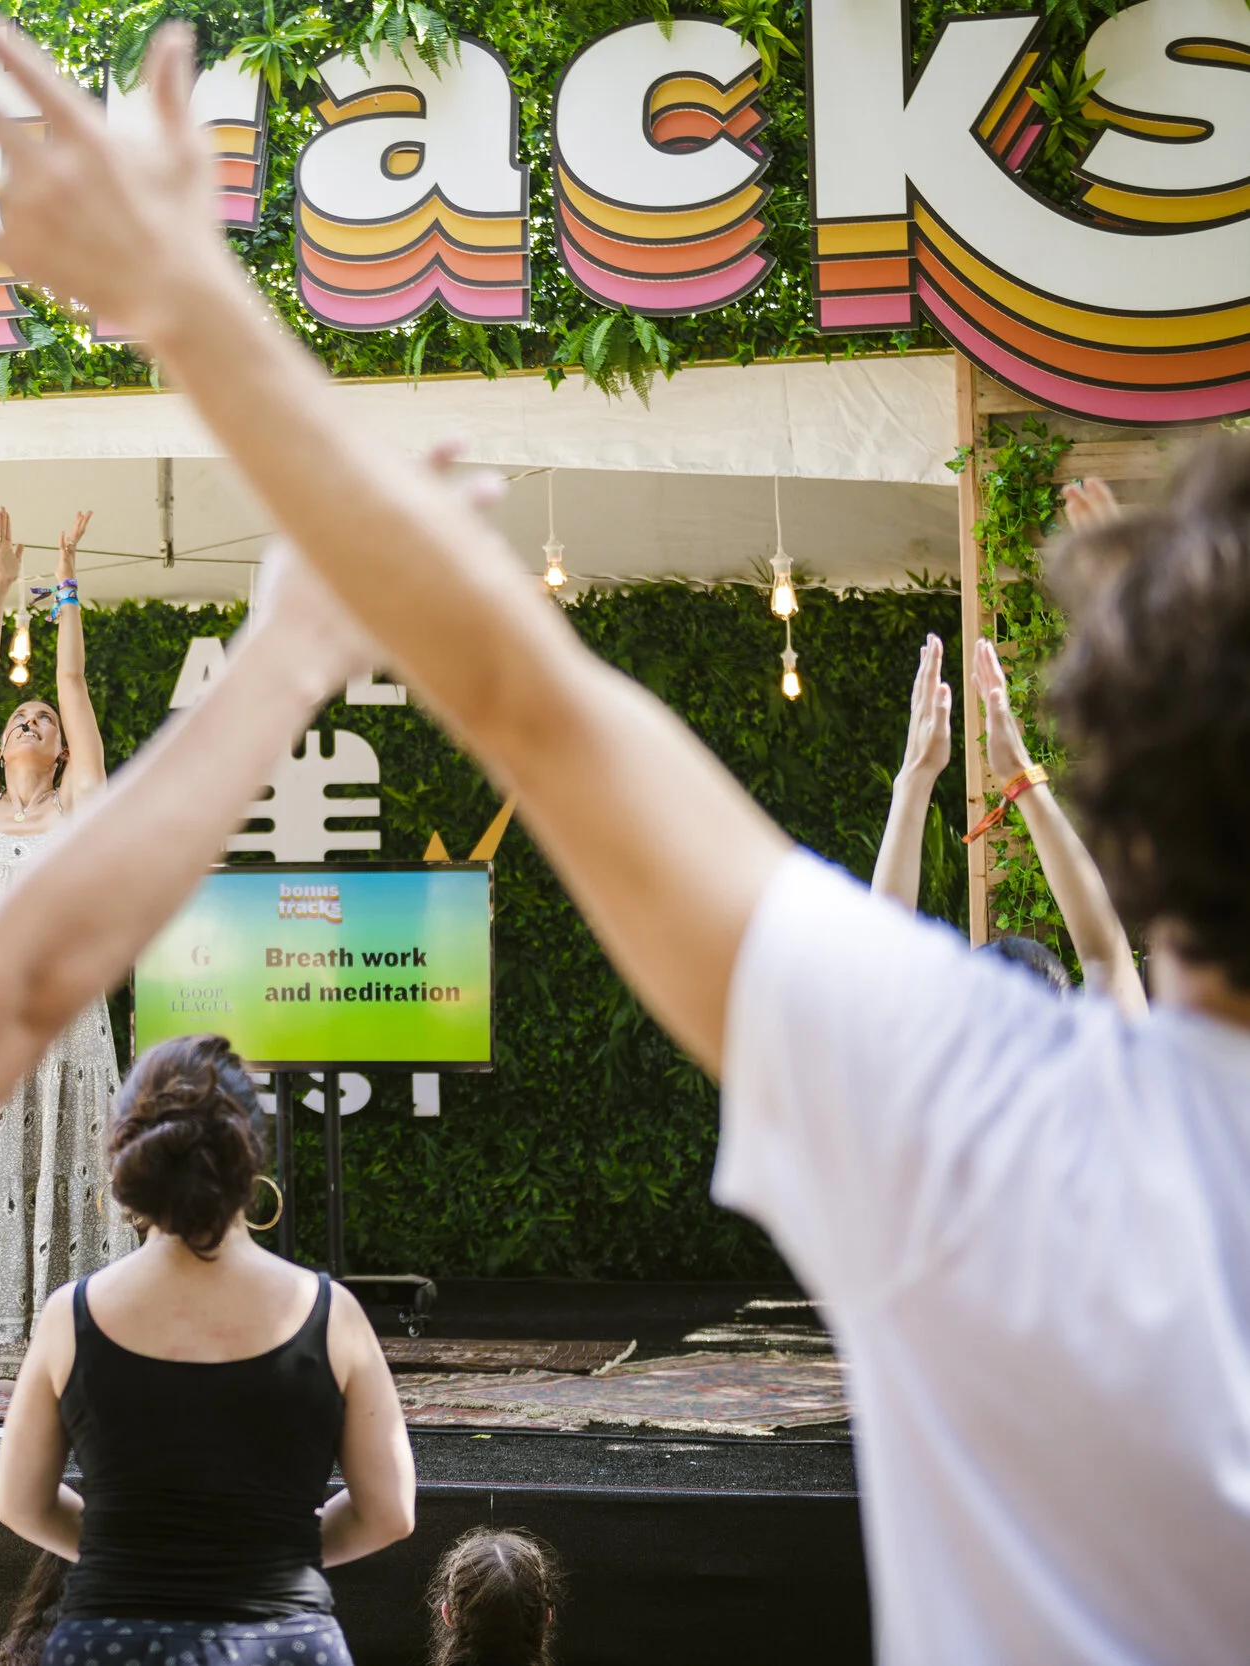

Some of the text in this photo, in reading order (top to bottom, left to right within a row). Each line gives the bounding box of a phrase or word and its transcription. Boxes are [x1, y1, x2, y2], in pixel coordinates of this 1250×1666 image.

[169, 636, 407, 709] AL
[279, 882, 340, 901] bonus
[277, 900, 344, 924] tracks
[265, 947, 428, 968] Breath work
[265, 982, 461, 1002] and meditation
